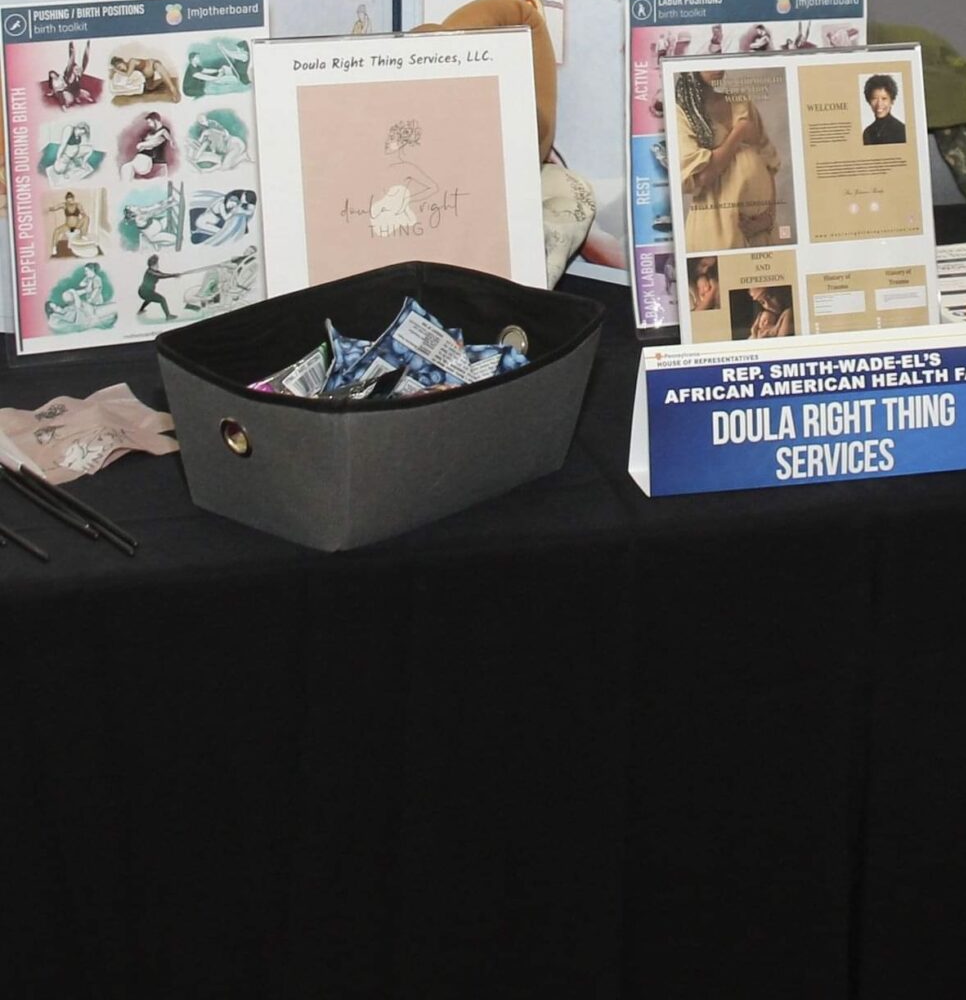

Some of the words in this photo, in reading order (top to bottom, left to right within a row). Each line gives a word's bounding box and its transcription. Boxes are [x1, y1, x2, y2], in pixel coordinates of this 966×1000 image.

[33, 7, 70, 22] PUSHING
[77, 5, 101, 19] BIRTH
[102, 3, 145, 16] POSITIONS
[658, 9, 678, 19] birth
[681, 8, 707, 19] toolkit
[34, 23, 55, 35] birth
[58, 22, 88, 33] toolkit
[293, 59, 326, 71] Doula
[332, 56, 364, 72] Right
[370, 55, 403, 70] Thing
[409, 53, 462, 66] Services,
[466, 50, 494, 63] LLC.
[633, 61, 649, 101] ACTIVE
[10, 87, 28, 123] BIRTH
[807, 102, 849, 113] WELCOME
[12, 126, 30, 172] DURING
[636, 175, 650, 206] REST
[15, 175, 34, 240] POSITIONS
[340, 194, 389, 224] doula
[418, 188, 470, 229] right
[368, 222, 424, 239] THING
[20, 242, 37, 297] HELPFUL
[640, 252, 655, 288] LABOR
[740, 274, 785, 284] DEPRESSION
[755, 263, 771, 271] AND
[643, 290, 657, 319] BACK
[657, 360, 681, 368] HOUSE
[694, 354, 759, 365] REPRESENTATIVES
[722, 365, 764, 383] REP.
[770, 352, 942, 381] SMITH-WADE-EL'S
[664, 385, 755, 405] AFRICAN
[760, 377, 866, 398] AMERICAN
[871, 369, 950, 389] HEALTH
[712, 405, 796, 446] DOULA
[802, 399, 877, 438] RIGHT
[885, 392, 957, 430] THING
[776, 438, 895, 481] SERVICES
